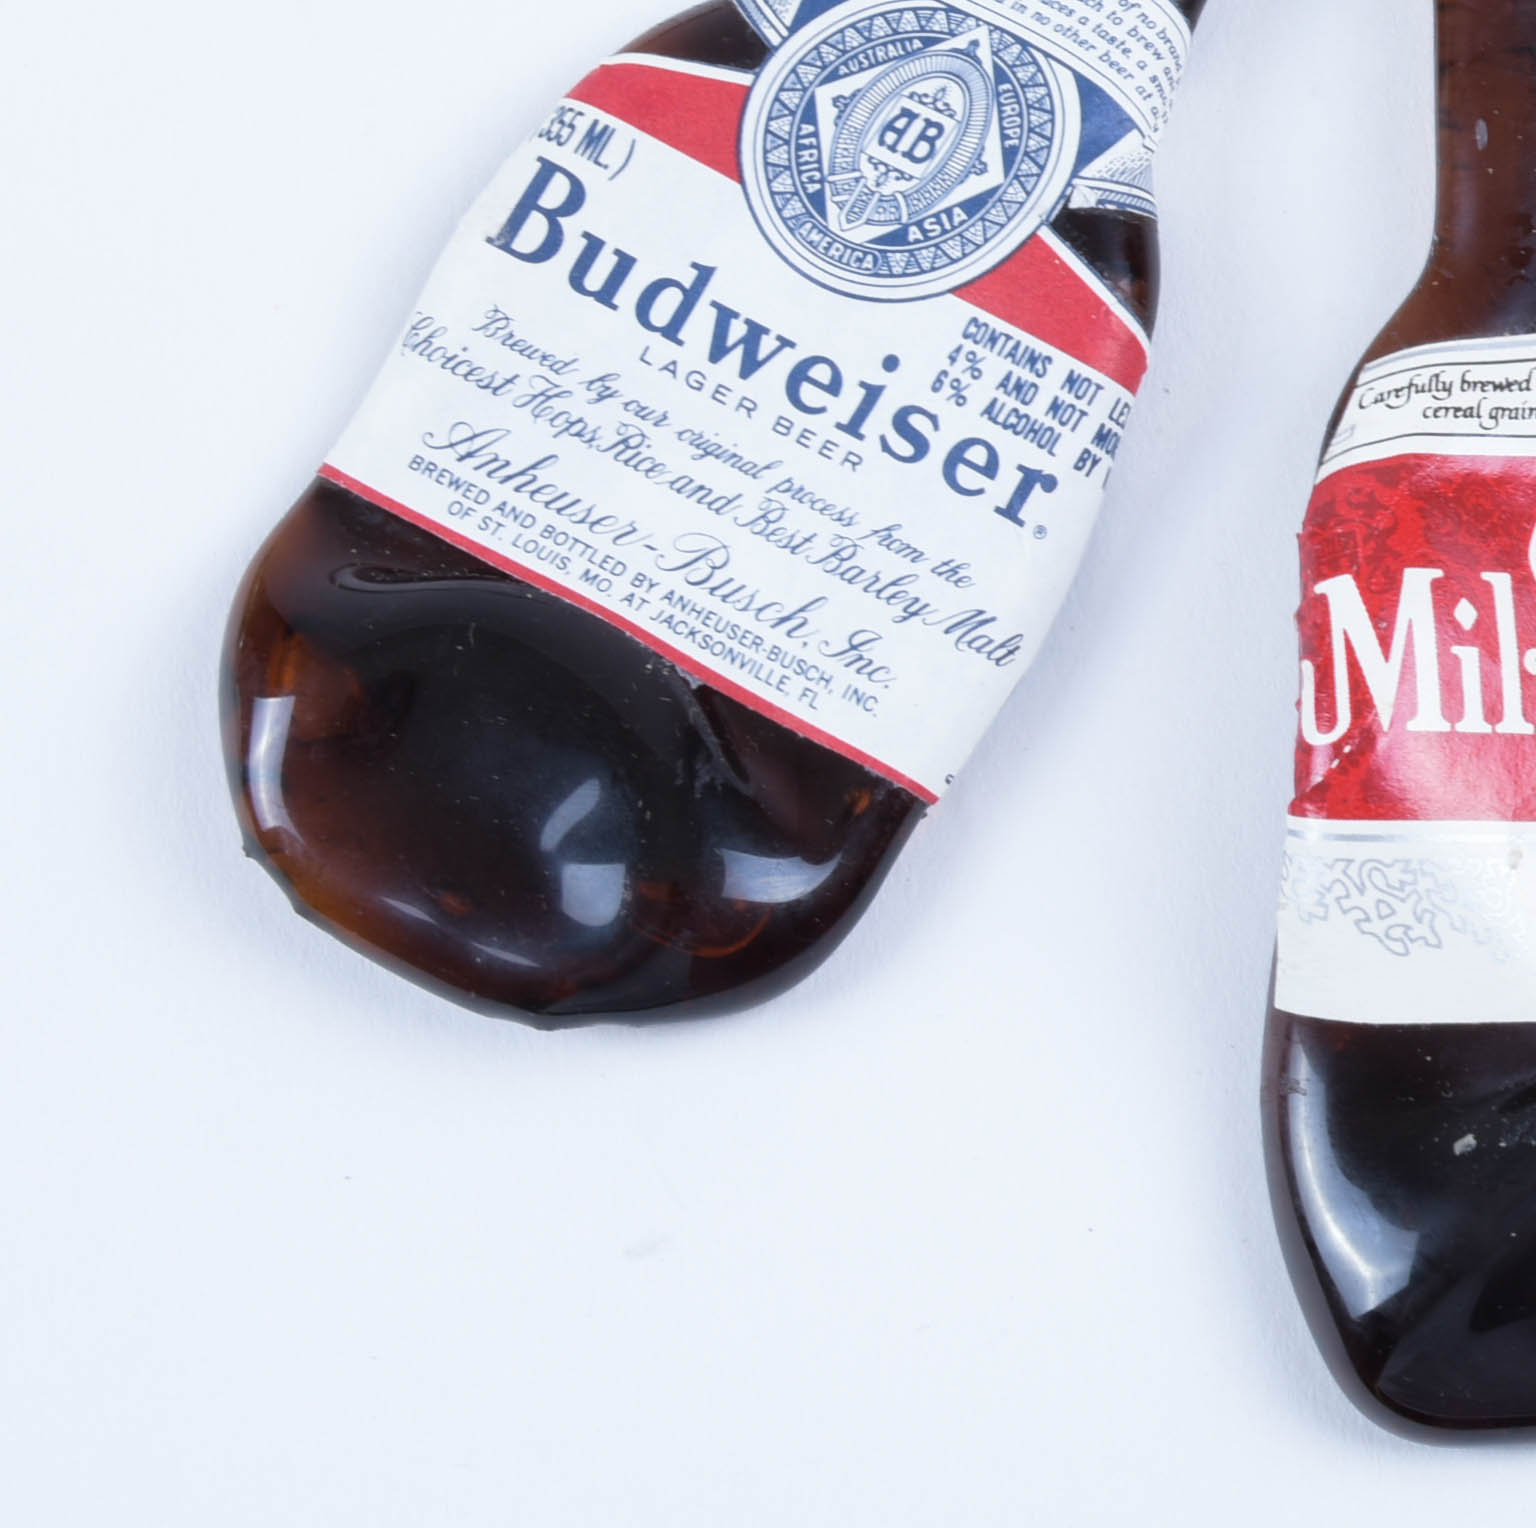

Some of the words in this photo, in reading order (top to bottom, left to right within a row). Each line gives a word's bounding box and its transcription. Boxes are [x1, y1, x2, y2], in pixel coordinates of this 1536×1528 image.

[838, 37, 924, 76] AUSTRALIA
[1031, 11, 1051, 26] no
[1053, 22, 1099, 52] other
[1098, 50, 1136, 82] beer
[1135, 84, 1153, 101] at
[1078, 16, 1090, 26] a
[1136, 60, 1148, 71] a
[1106, 10, 1124, 26] to
[1126, 25, 1166, 62] brew
[1136, 13, 1158, 30] no
[998, 83, 1022, 149] EUROPE
[797, 123, 822, 194] AFRICA
[799, 224, 876, 271] AMERICA
[907, 206, 968, 243] ASIA
[485, 155, 1058, 529] Budweiser
[961, 316, 1053, 379] CONTAINS
[1060, 368, 1104, 407] NOT
[639, 345, 761, 420] LAGER
[771, 416, 864, 472] BEER
[931, 369, 971, 408] 6%
[980, 397, 1063, 457] ALCOHOL
[1073, 447, 1102, 478] BY
[947, 343, 987, 380] 4%
[995, 370, 1039, 407] AND
[1045, 395, 1089, 433] NOT
[1358, 370, 1454, 409] Carefully
[1422, 397, 1489, 419] cereal
[472, 304, 580, 376] Brewed
[578, 372, 623, 405] by
[622, 399, 671, 427] our
[675, 428, 783, 480] original
[766, 477, 859, 527] process
[858, 523, 930, 564] from
[930, 558, 975, 590] the
[597, 421, 672, 484] Rice
[668, 473, 743, 517] and
[733, 496, 817, 556] Best
[806, 533, 937, 623] Barley
[922, 609, 1024, 668] Malt
[408, 454, 491, 506] BREWED
[492, 500, 537, 530] AND
[540, 524, 628, 578] BOTTLED
[630, 572, 663, 594] BY
[660, 589, 836, 695] ANHEUSER-BUSCH,
[841, 684, 880, 718] INC.
[447, 500, 477, 520] OF
[477, 516, 506, 542] ST.
[578, 570, 614, 599] MO.
[619, 592, 650, 613] AT
[799, 686, 821, 712] FL
[818, 628, 897, 689] Inc.
